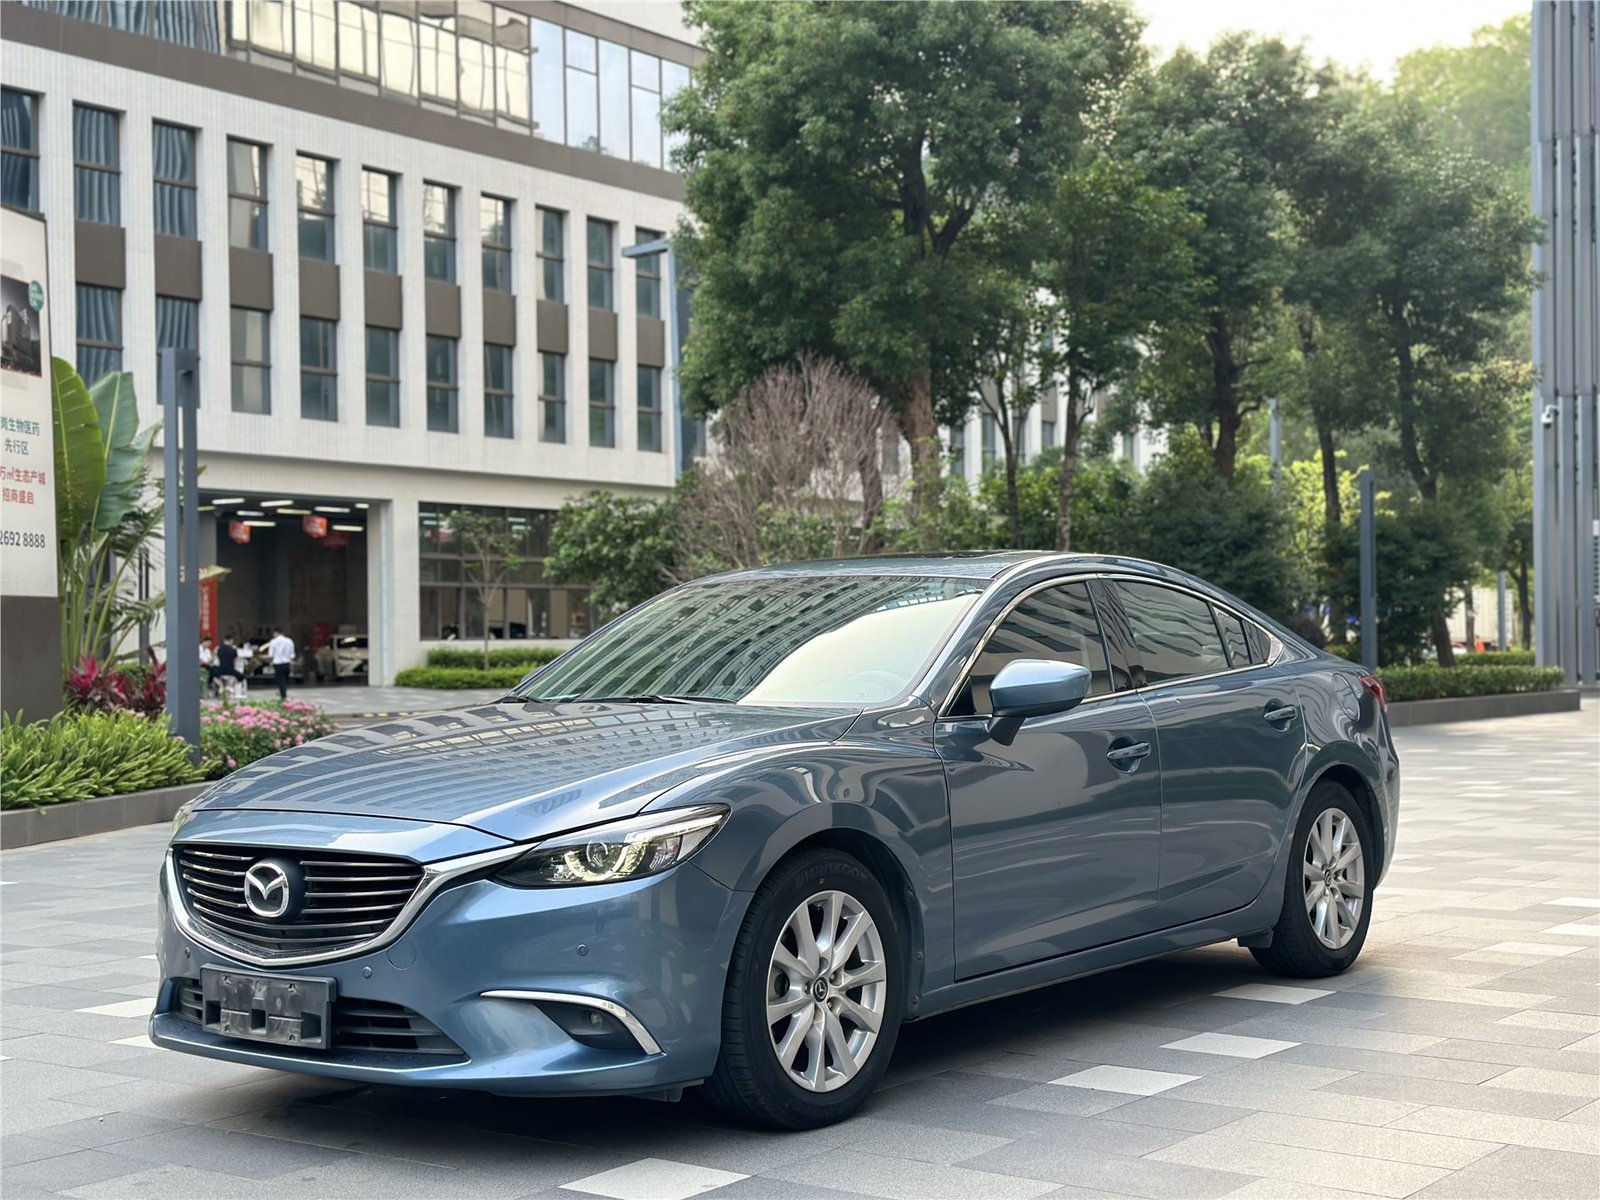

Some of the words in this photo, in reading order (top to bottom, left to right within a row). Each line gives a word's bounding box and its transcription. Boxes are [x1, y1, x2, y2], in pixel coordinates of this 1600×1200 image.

[4, 437, 29, 455] 先行区
[23, 532, 46, 549] 8888
